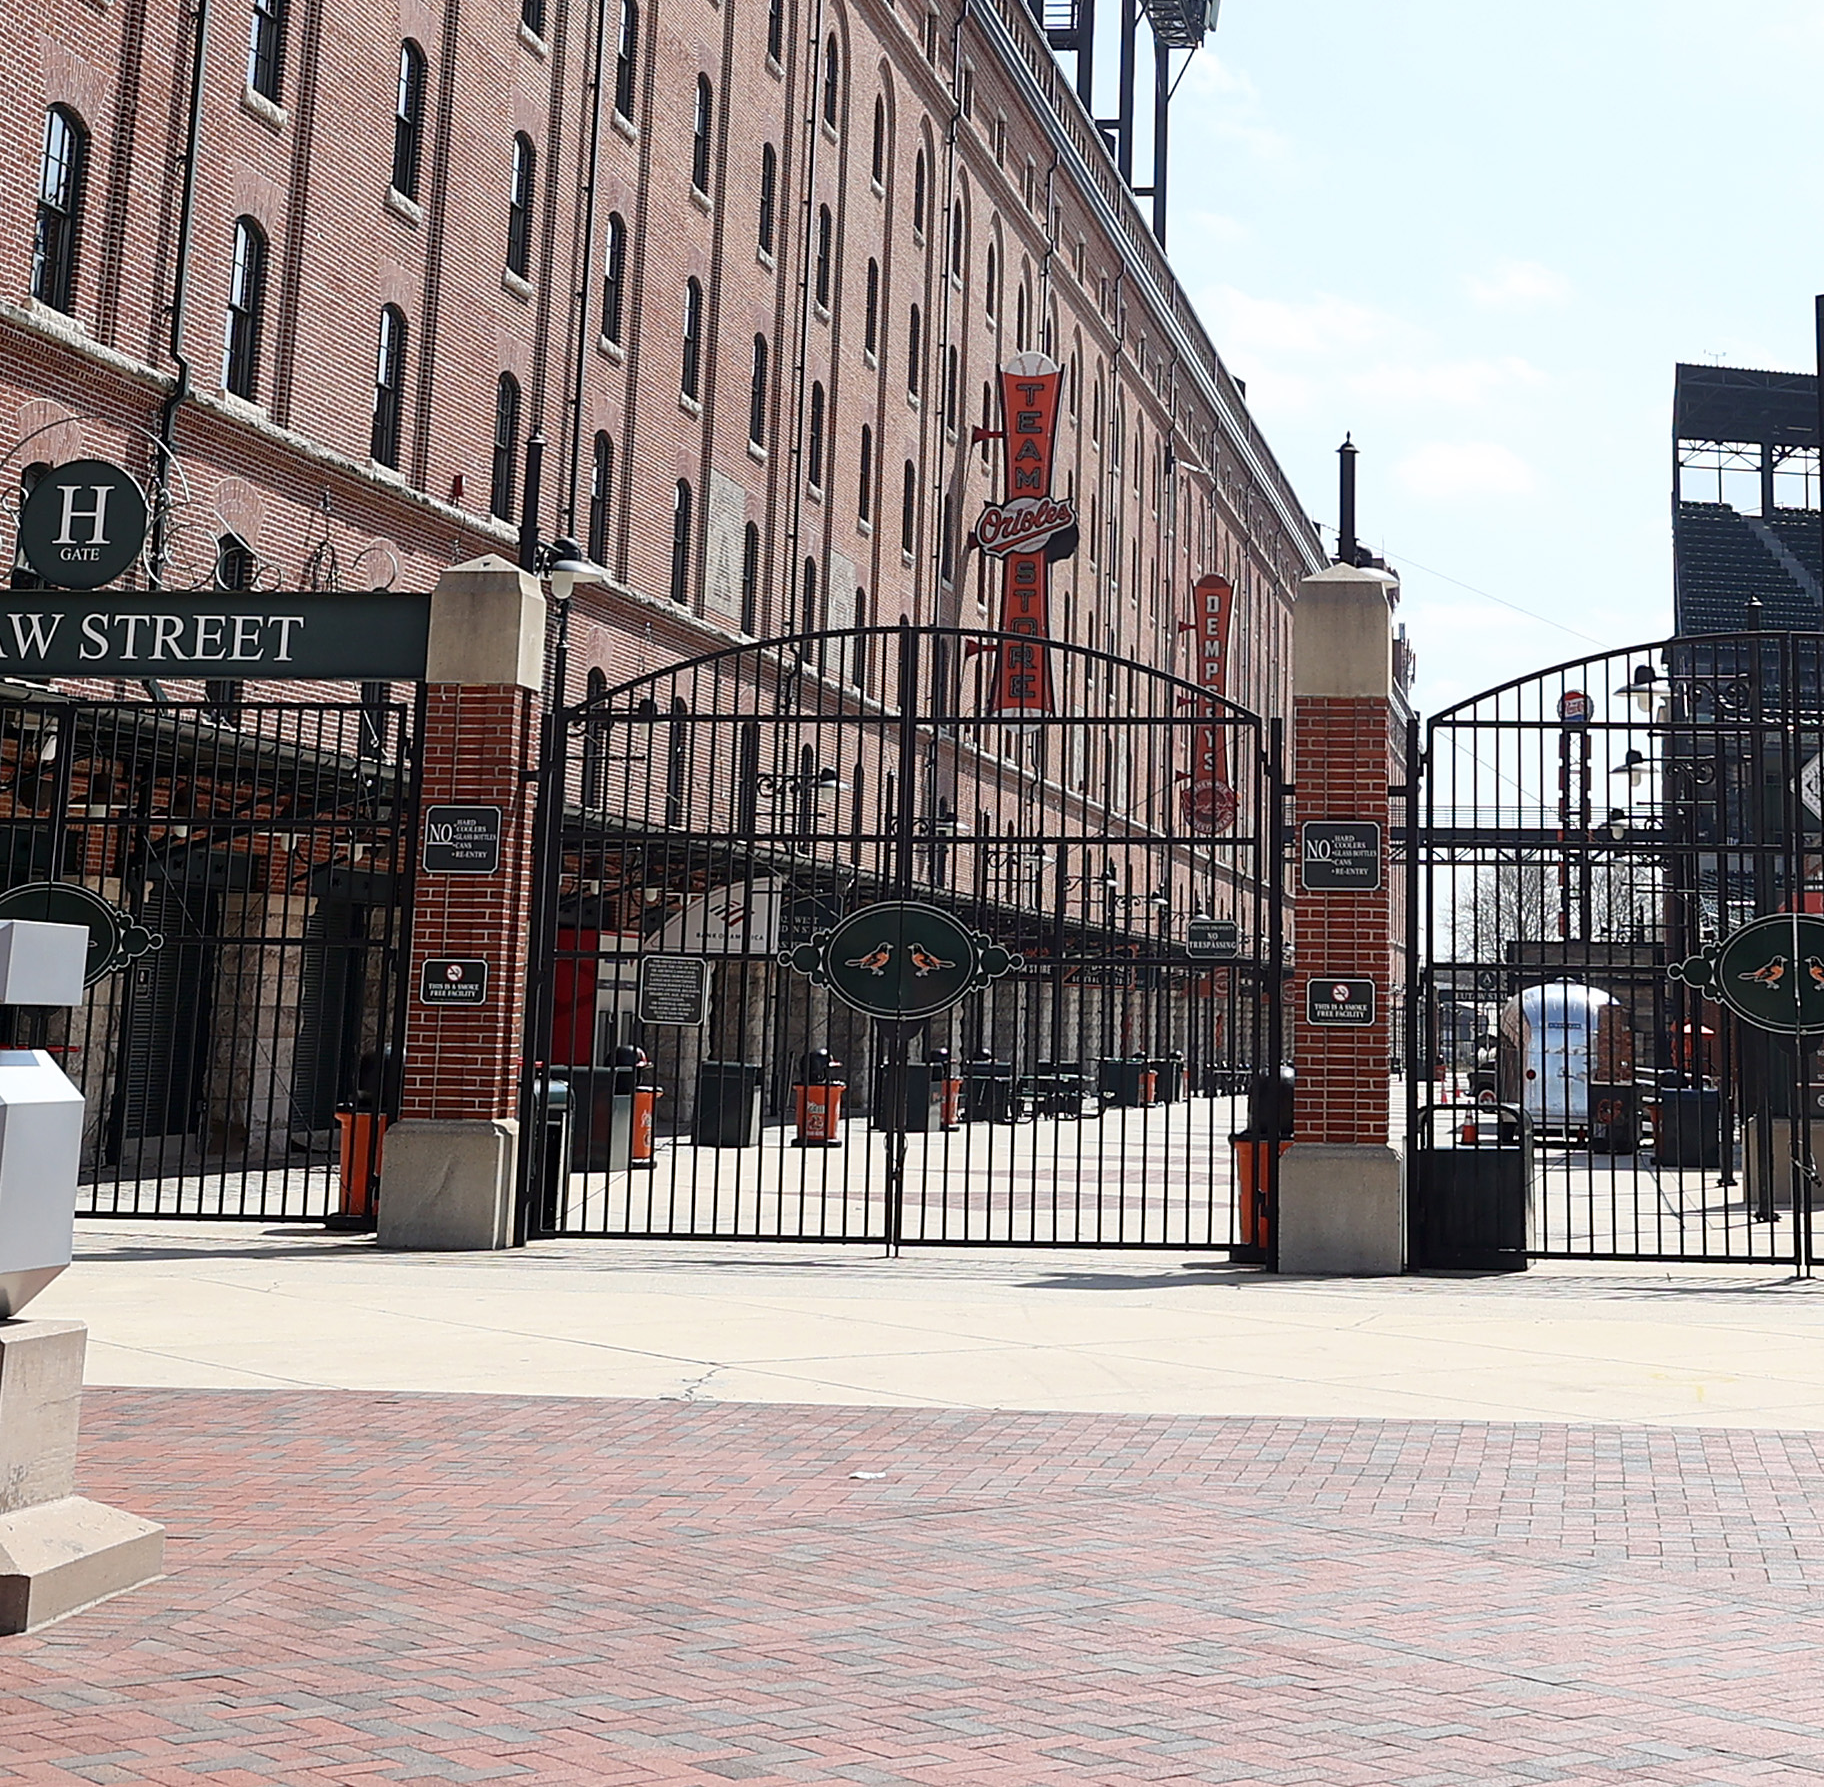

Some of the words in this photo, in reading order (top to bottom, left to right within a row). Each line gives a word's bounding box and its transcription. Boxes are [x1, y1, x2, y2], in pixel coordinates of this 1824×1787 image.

[1016, 383, 1045, 490] TEAM
[51, 484, 117, 545] H
[980, 499, 1074, 546] Orioles
[60, 546, 102, 563] GATE
[1008, 560, 1039, 699] STORE
[78, 613, 305, 662] STREET
[429, 823, 453, 842] NO
[456, 825, 487, 833] COOLERS
[455, 833, 472, 841] GLASS
[474, 833, 497, 842] BOTTLES
[455, 842, 472, 850] CANS
[1334, 841, 1366, 849] COOLERS
[1306, 840, 1331, 860] NO
[1334, 849, 1352, 857] GLASS
[455, 851, 488, 859] RE-ENTRY
[1335, 868, 1368, 876] RE-ENTRY
[1207, 932, 1219, 940] NO
[1189, 941, 1236, 949] TRESPASSING
[1482, 973, 1492, 983] A
[457, 983, 480, 991] SMOKE
[447, 990, 477, 998] FACILITY
[1338, 1003, 1344, 1011] A
[1344, 1003, 1368, 1011] SMOKE
[1334, 1010, 1364, 1018] FACILITY
